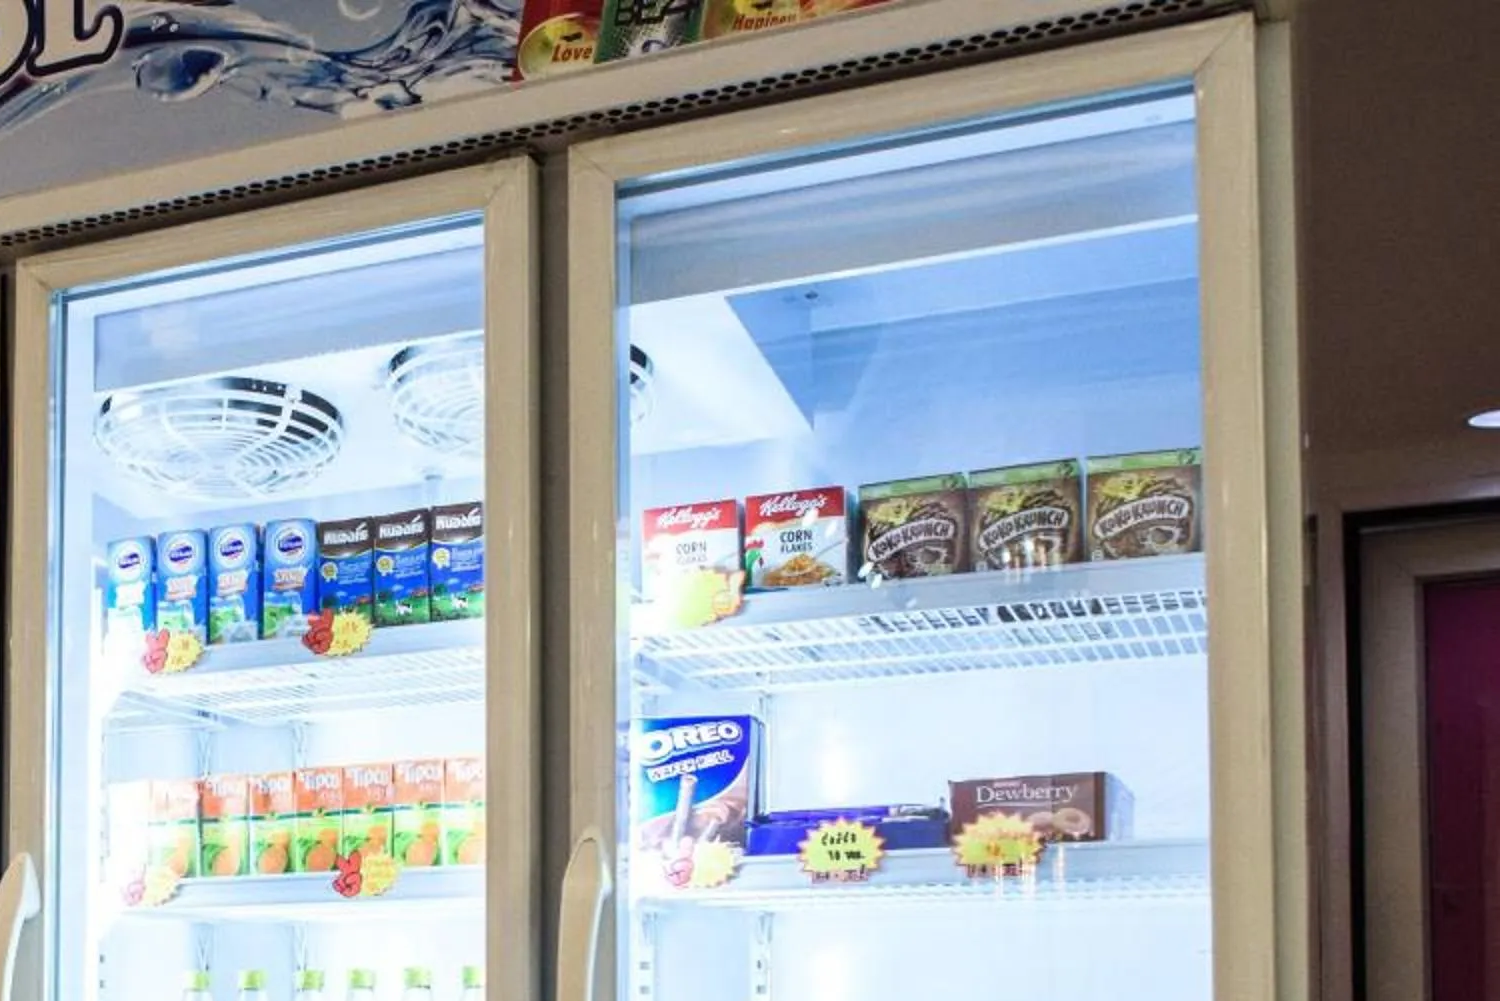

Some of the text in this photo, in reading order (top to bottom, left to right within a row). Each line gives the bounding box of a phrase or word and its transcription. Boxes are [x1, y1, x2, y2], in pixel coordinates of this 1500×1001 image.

[551, 44, 593, 63] Love
[760, 494, 828, 518] Kellogg's
[656, 507, 721, 530] Kellogg's
[779, 529, 813, 545] CORN
[779, 543, 813, 555] FLAKES
[638, 720, 742, 761] OREO
[975, 781, 1079, 804] Dewberry
